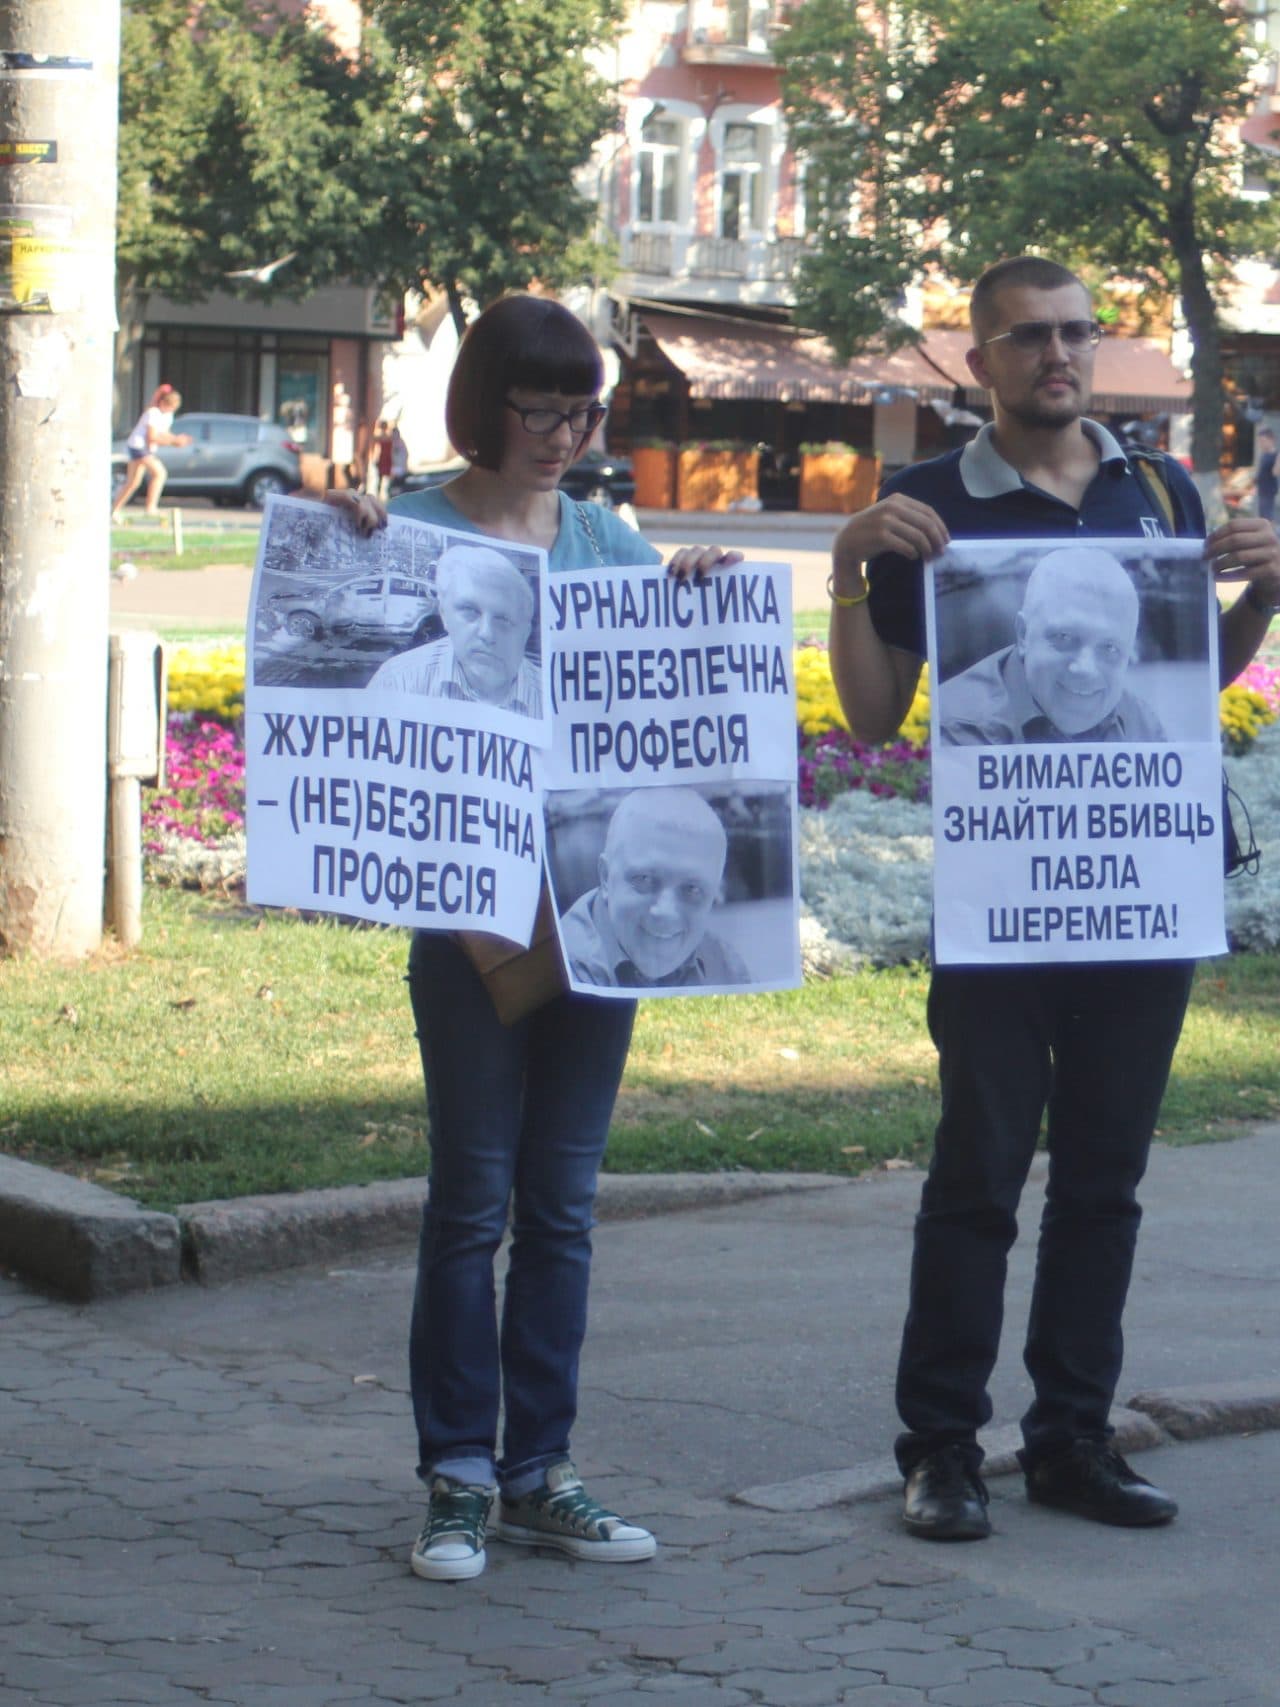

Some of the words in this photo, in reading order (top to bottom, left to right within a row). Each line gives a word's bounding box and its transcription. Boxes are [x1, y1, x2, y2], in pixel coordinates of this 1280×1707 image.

[550, 575, 780, 630] УРНАЛІСТИКА
[550, 644, 788, 714] (НЕ)БЕЗПЕЧНА
[263, 713, 533, 792] ЖУРНАЛІСТИКА
[571, 714, 749, 773] ПРОФЕСІЯ
[978, 752, 1182, 790] ВИМАГАЄМО
[290, 776, 536, 863] (НЕ)БЕЗПЕЧНА
[944, 797, 1077, 842] ЗНАЙТИ
[1087, 803, 1215, 844] ВБИВЦЬ
[313, 844, 496, 917] ПРОФЕСІЯ
[1031, 855, 1140, 891] ПАВЛА
[988, 904, 1177, 942] ШЕРЕМЕТА!
